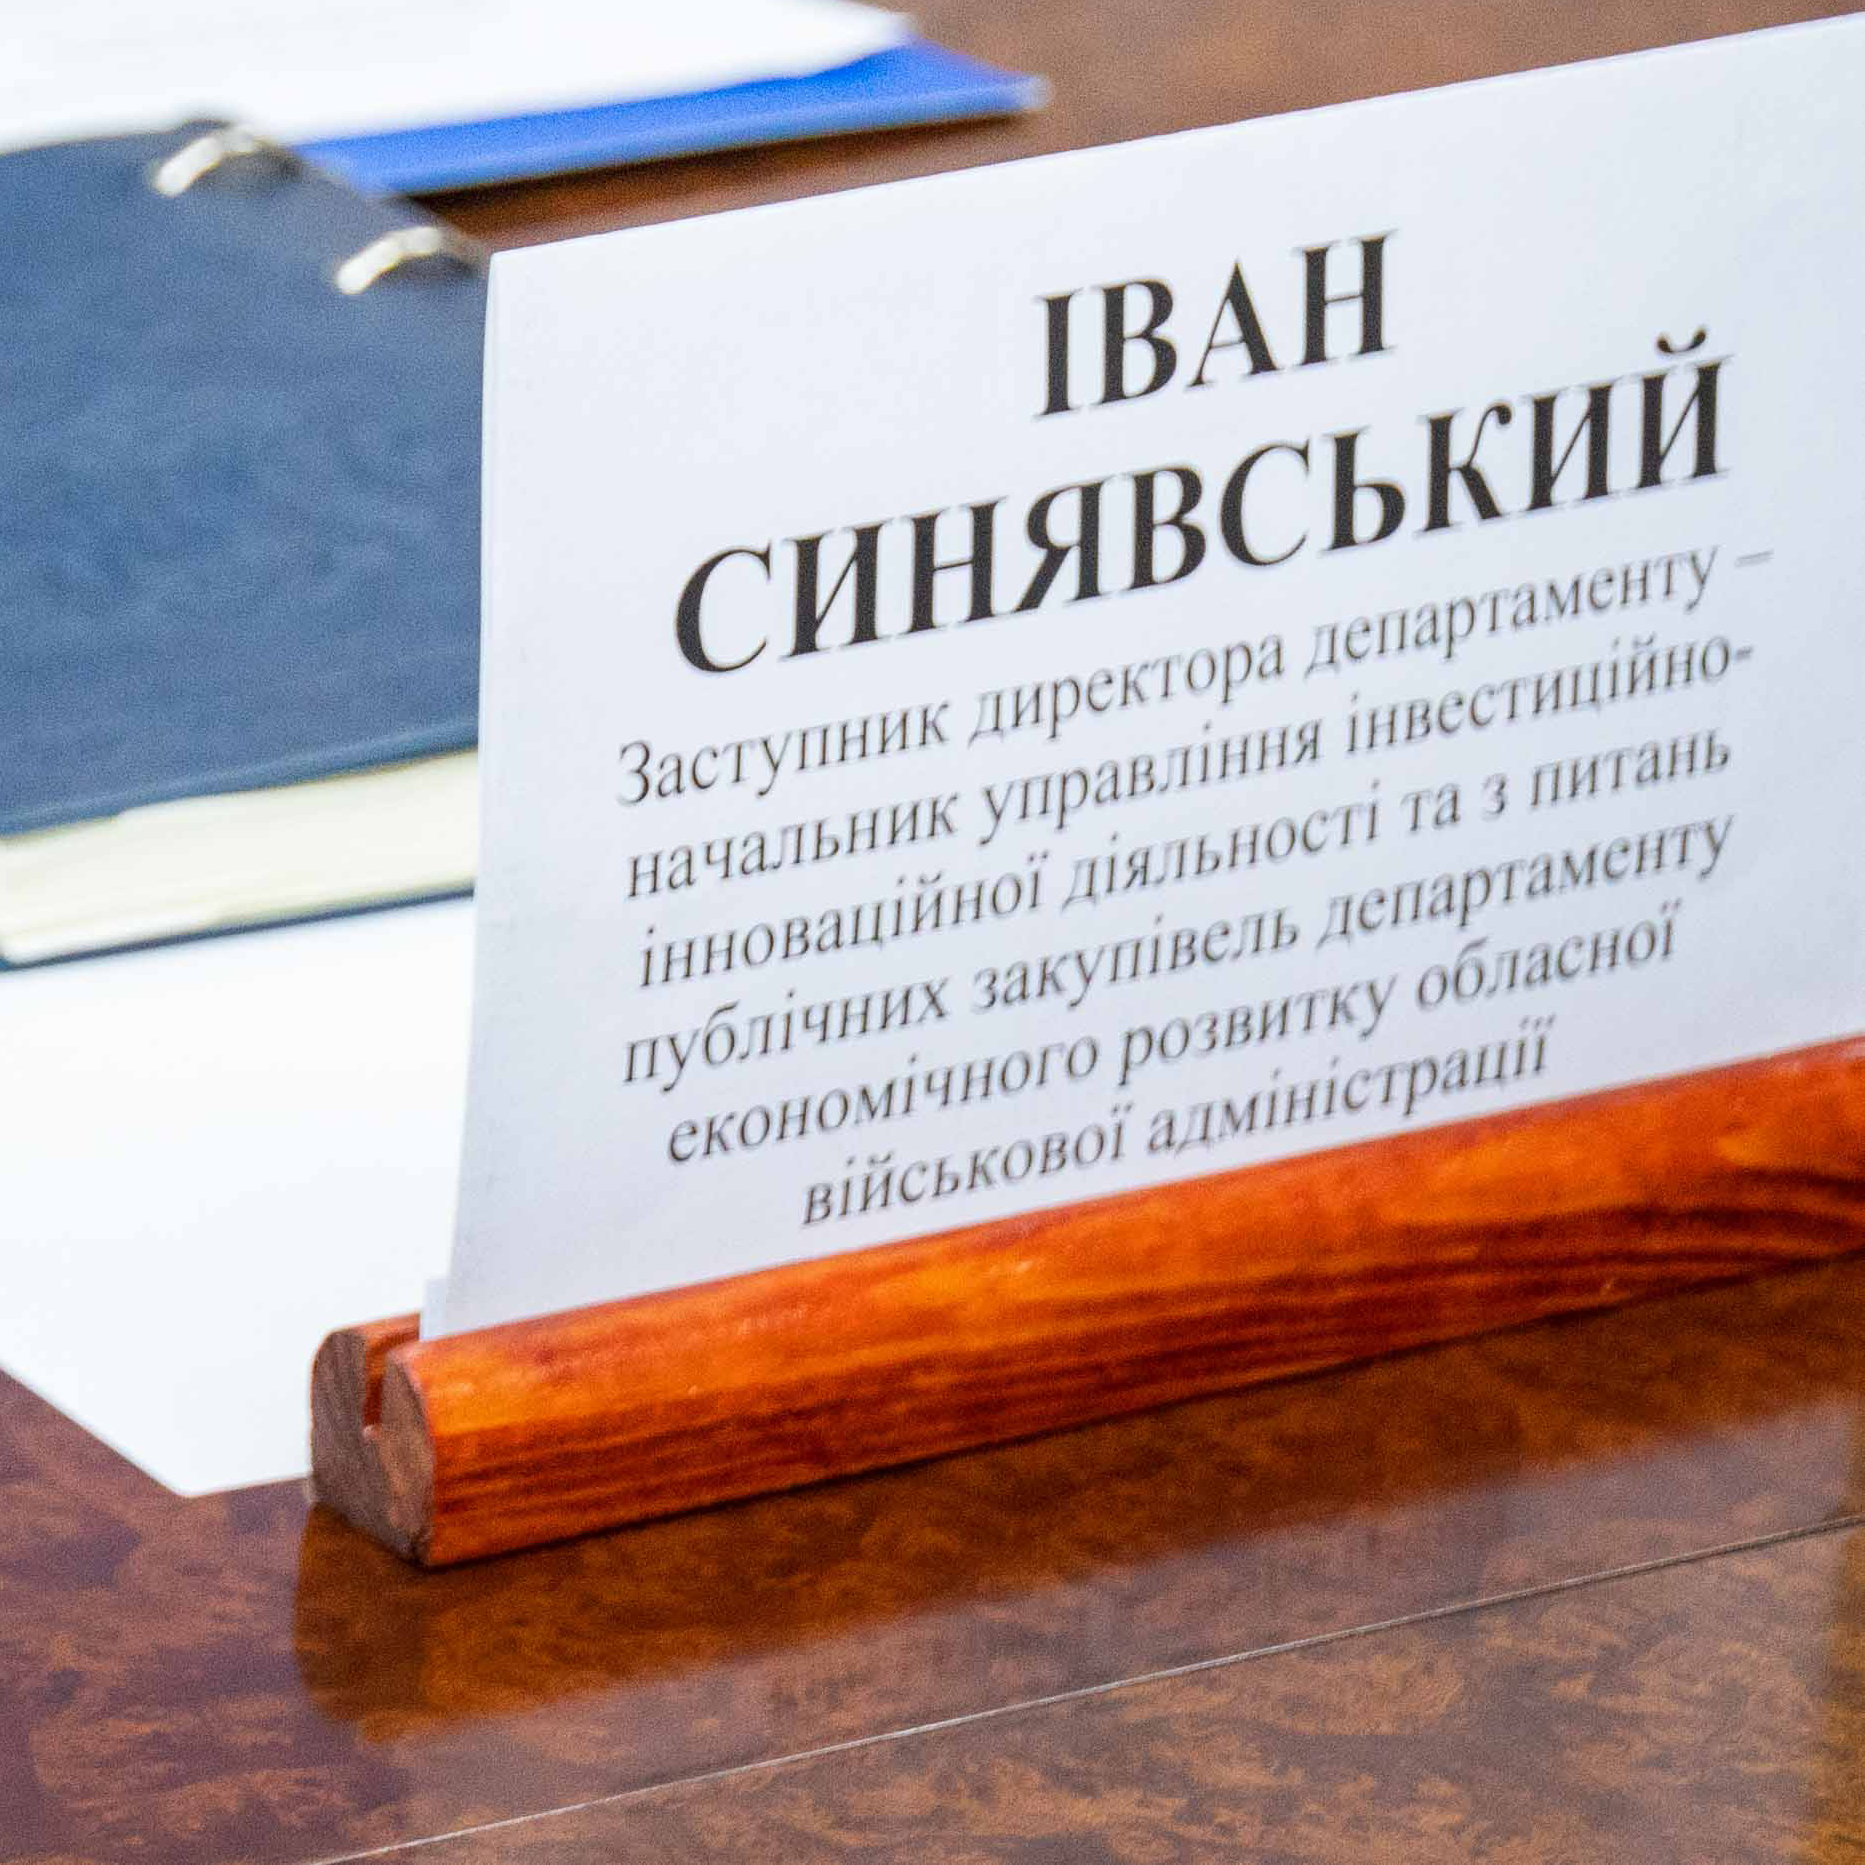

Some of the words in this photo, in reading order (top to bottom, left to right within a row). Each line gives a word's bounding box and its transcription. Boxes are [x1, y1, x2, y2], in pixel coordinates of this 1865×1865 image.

[1031, 229, 1398, 419] ІВАН
[674, 326, 1735, 675] СИНЯВСЬКИЙ
[618, 701, 950, 807] Заступник
[968, 635, 1285, 747] директора
[1304, 546, 1718, 679] департаменту
[627, 792, 960, 900] начальник
[978, 719, 1322, 848] управління
[1347, 636, 1754, 756] інвестиційно-
[623, 977, 949, 1089] публічних
[974, 908, 1300, 1013] закупівель
[1316, 815, 1734, 949] департаменту
[639, 850, 1049, 990] інноваційної
[1061, 779, 1380, 912] діяльності
[1401, 783, 1461, 835] та
[1483, 774, 1508, 819] з
[1530, 730, 1731, 810] питань
[667, 1036, 1100, 1166] економічного
[1117, 975, 1397, 1090] розвитку
[1416, 898, 1682, 1011] обласної
[802, 1101, 1134, 1228] військової
[1147, 1014, 1556, 1155] адміністрації
